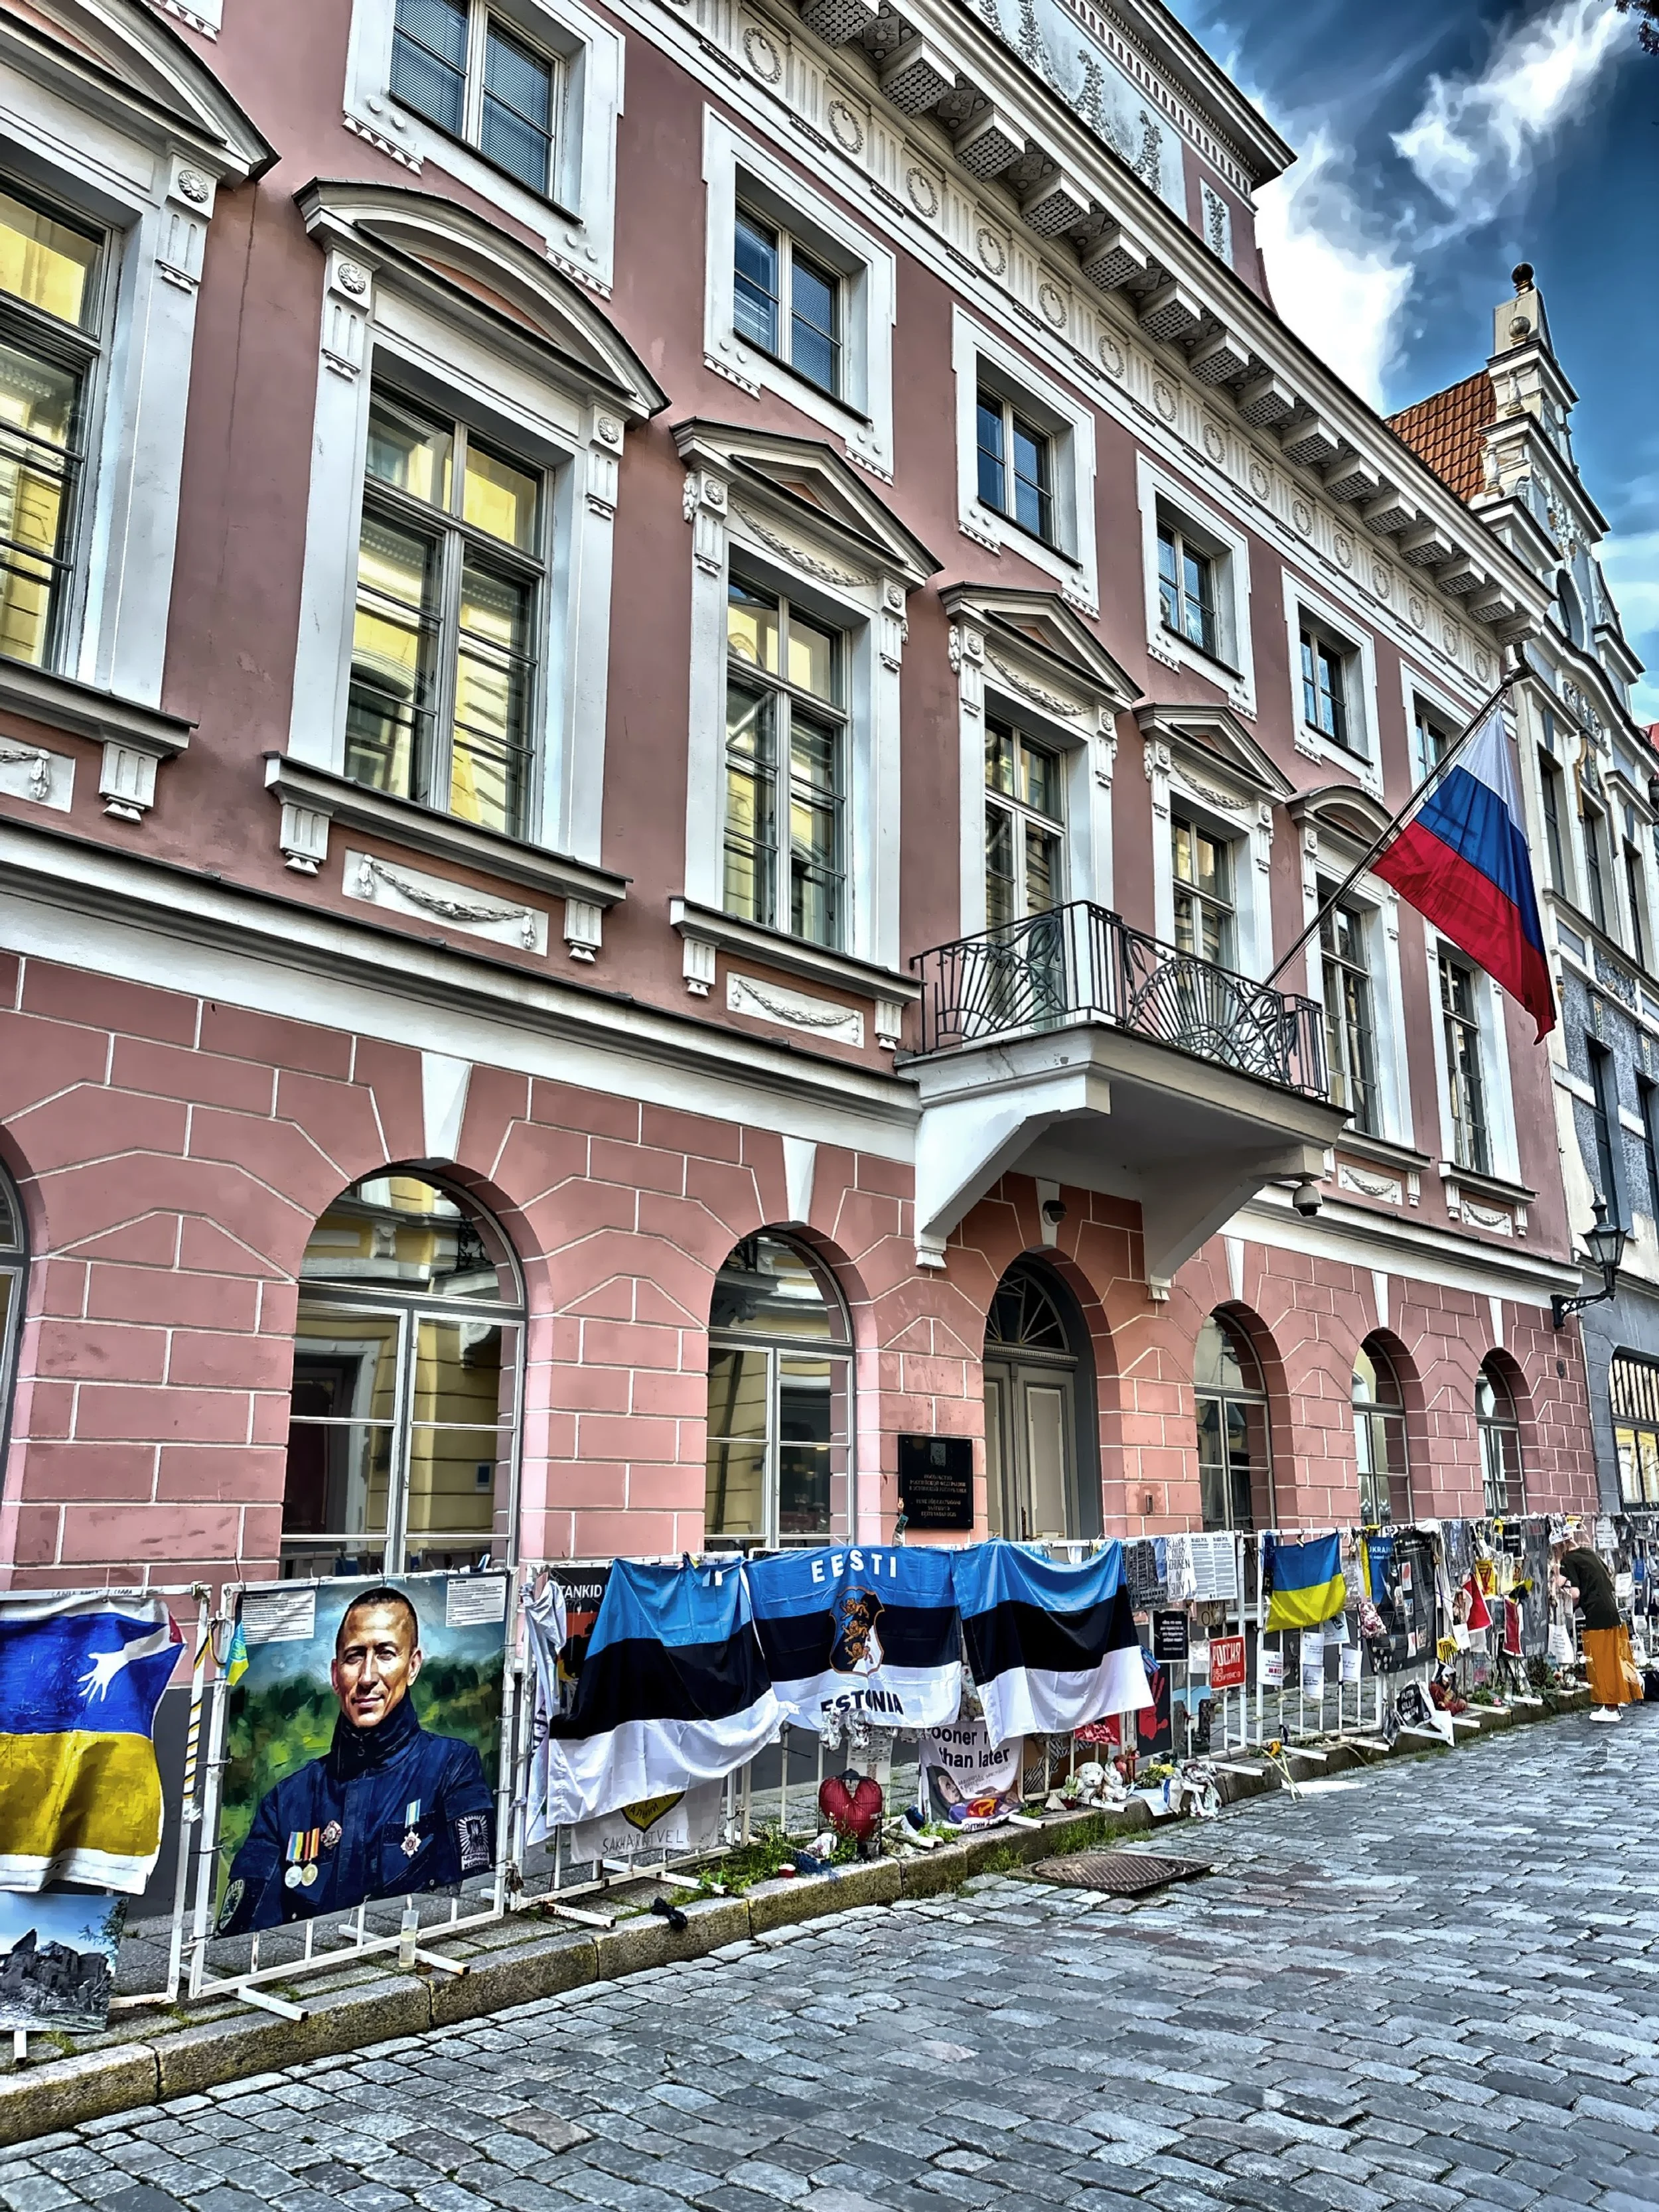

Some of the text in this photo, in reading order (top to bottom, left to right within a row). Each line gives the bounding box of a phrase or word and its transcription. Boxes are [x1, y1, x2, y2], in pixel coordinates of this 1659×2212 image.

[811, 1549, 896, 1583] EESTI
[820, 1689, 904, 1715] ESTONIA
[930, 1726, 977, 1746] ooner
[939, 1747, 1009, 1768] than later
